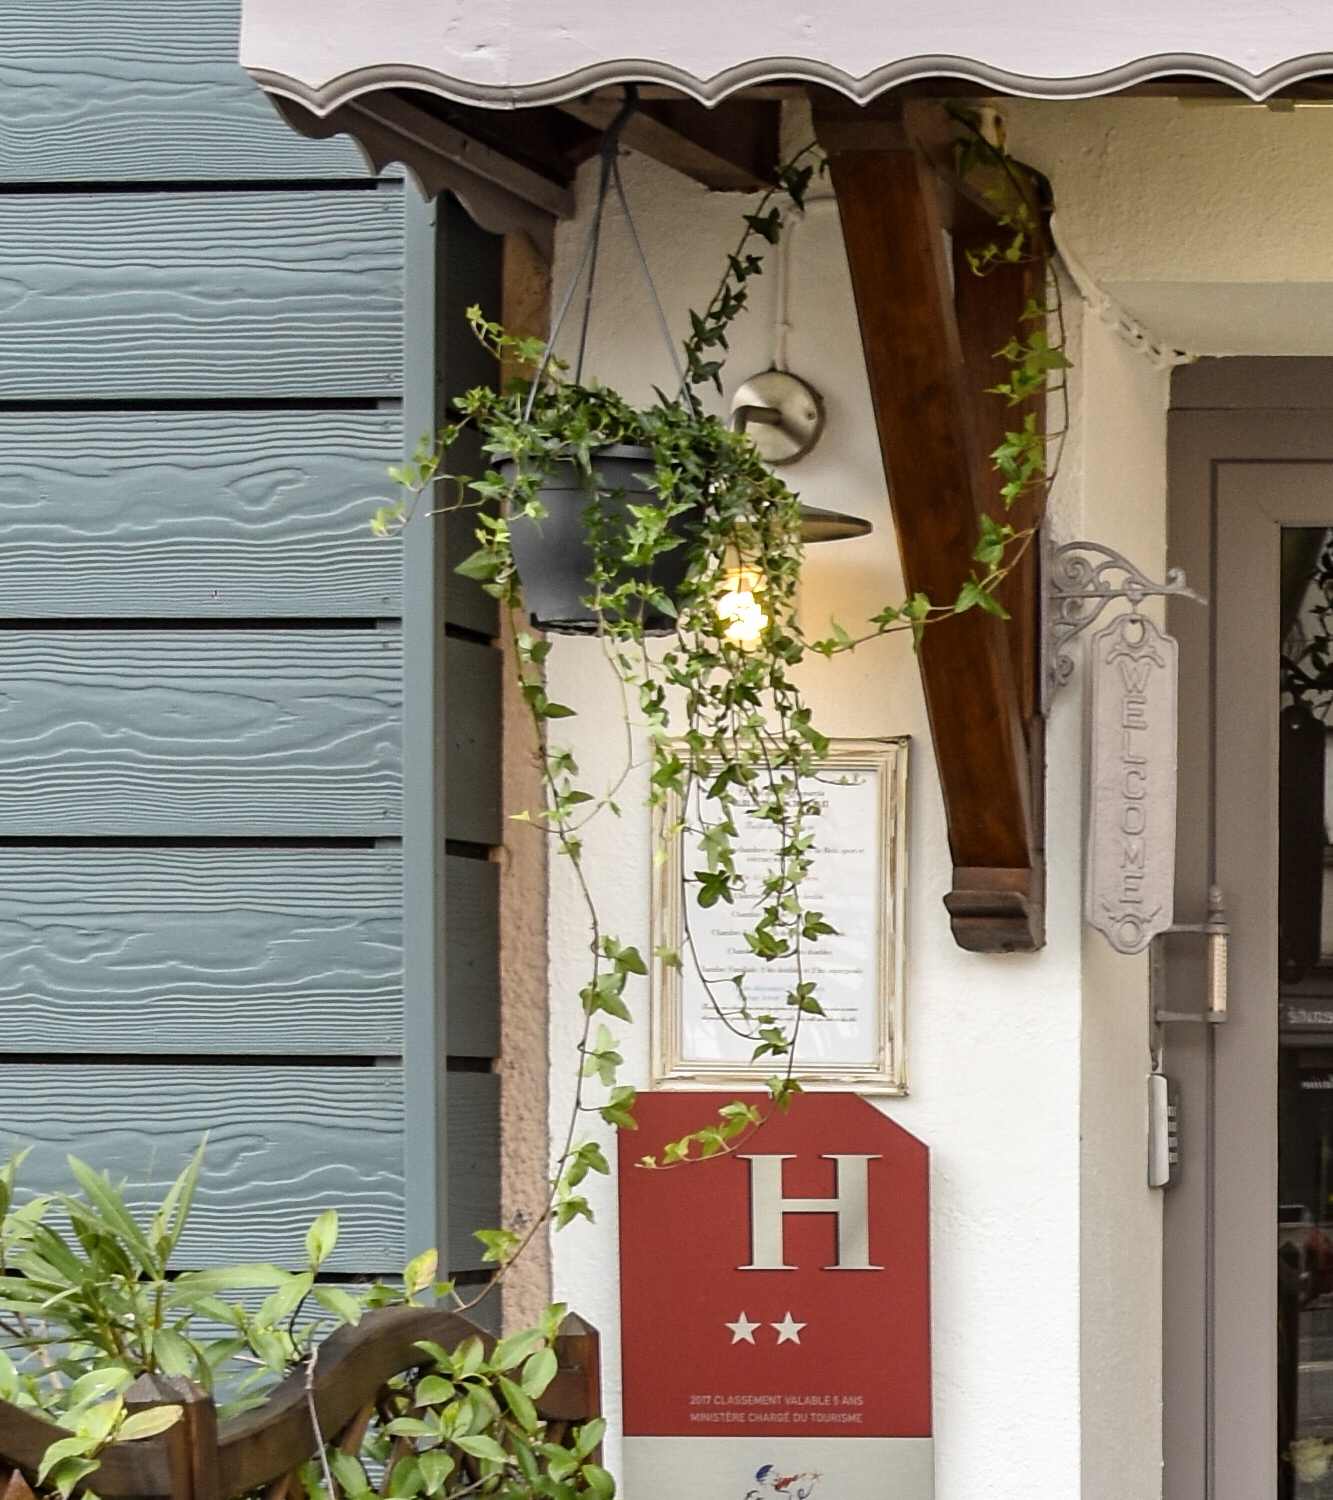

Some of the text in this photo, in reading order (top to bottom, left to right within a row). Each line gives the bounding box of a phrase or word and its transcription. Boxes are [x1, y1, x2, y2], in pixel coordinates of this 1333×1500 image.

[1117, 660, 1152, 905] WELCOME
[734, 1153, 886, 1272] H
[714, 1395, 783, 1406] CLASSEMENT
[784, 1395, 831, 1406] VALABLE
[841, 1395, 865, 1406] ANS
[792, 1412, 809, 1423] DU
[810, 1412, 864, 1423] TOURISME
